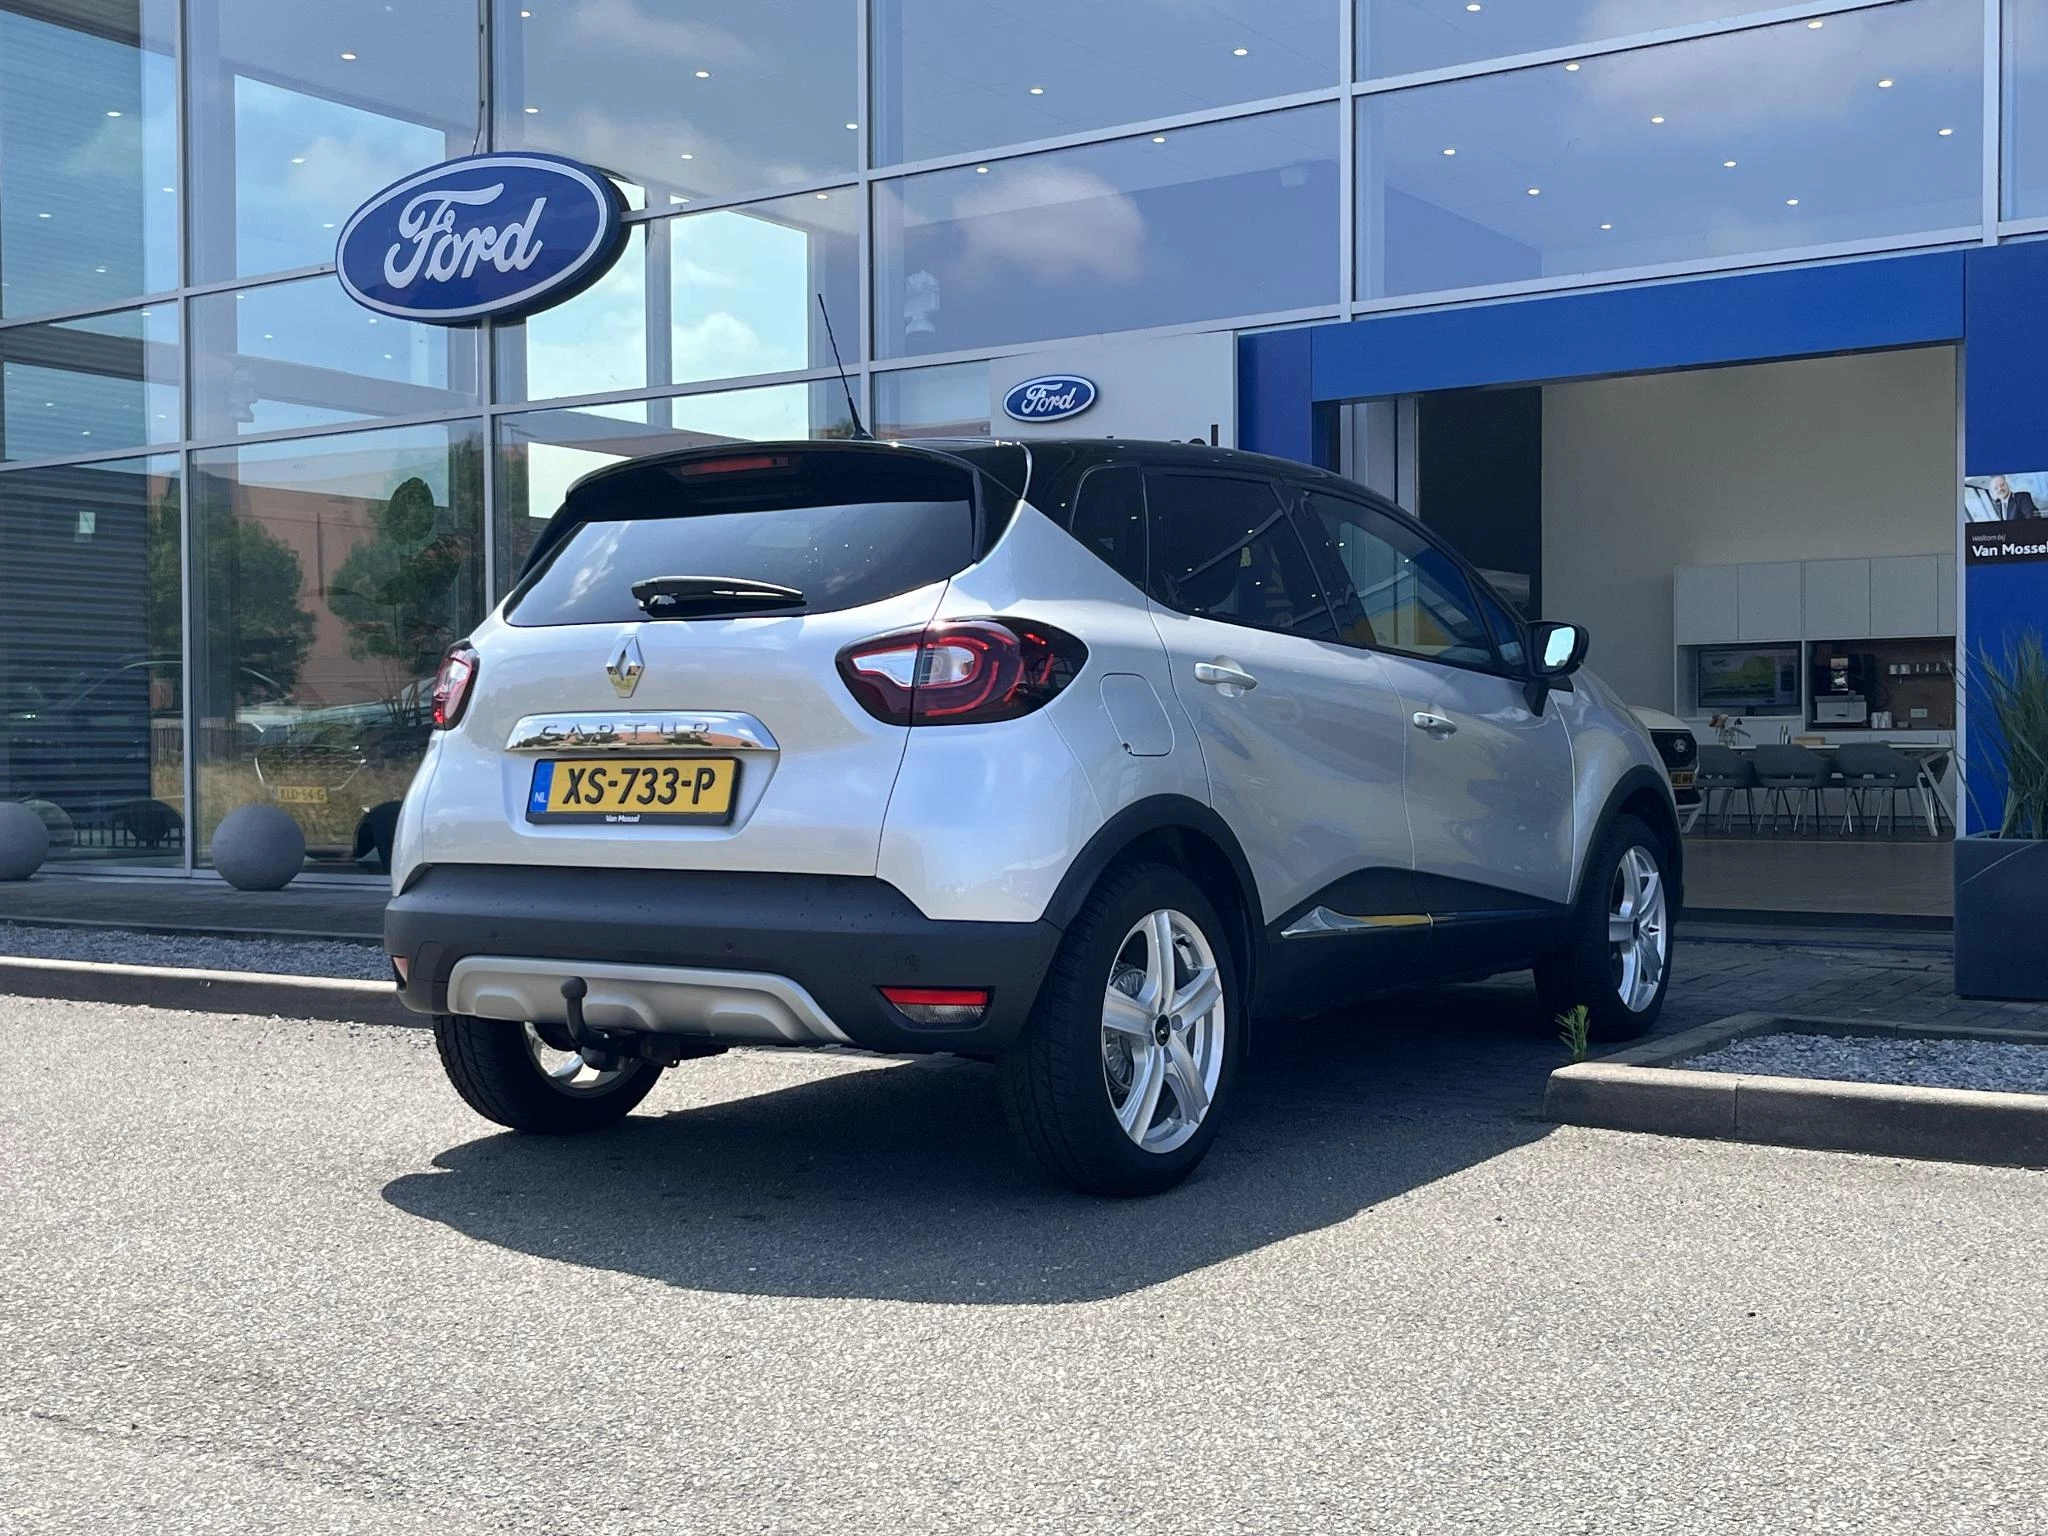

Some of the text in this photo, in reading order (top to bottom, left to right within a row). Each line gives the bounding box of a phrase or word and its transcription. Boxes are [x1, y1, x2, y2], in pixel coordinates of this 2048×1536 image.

[384, 183, 547, 289] Ford
[1021, 383, 1077, 414] Ford
[1972, 545, 1998, 557] Van
[541, 721, 711, 742] CAPTUR
[562, 767, 716, 805] XS-733-P
[534, 791, 546, 803] NL
[618, 814, 640, 823] Mossel
